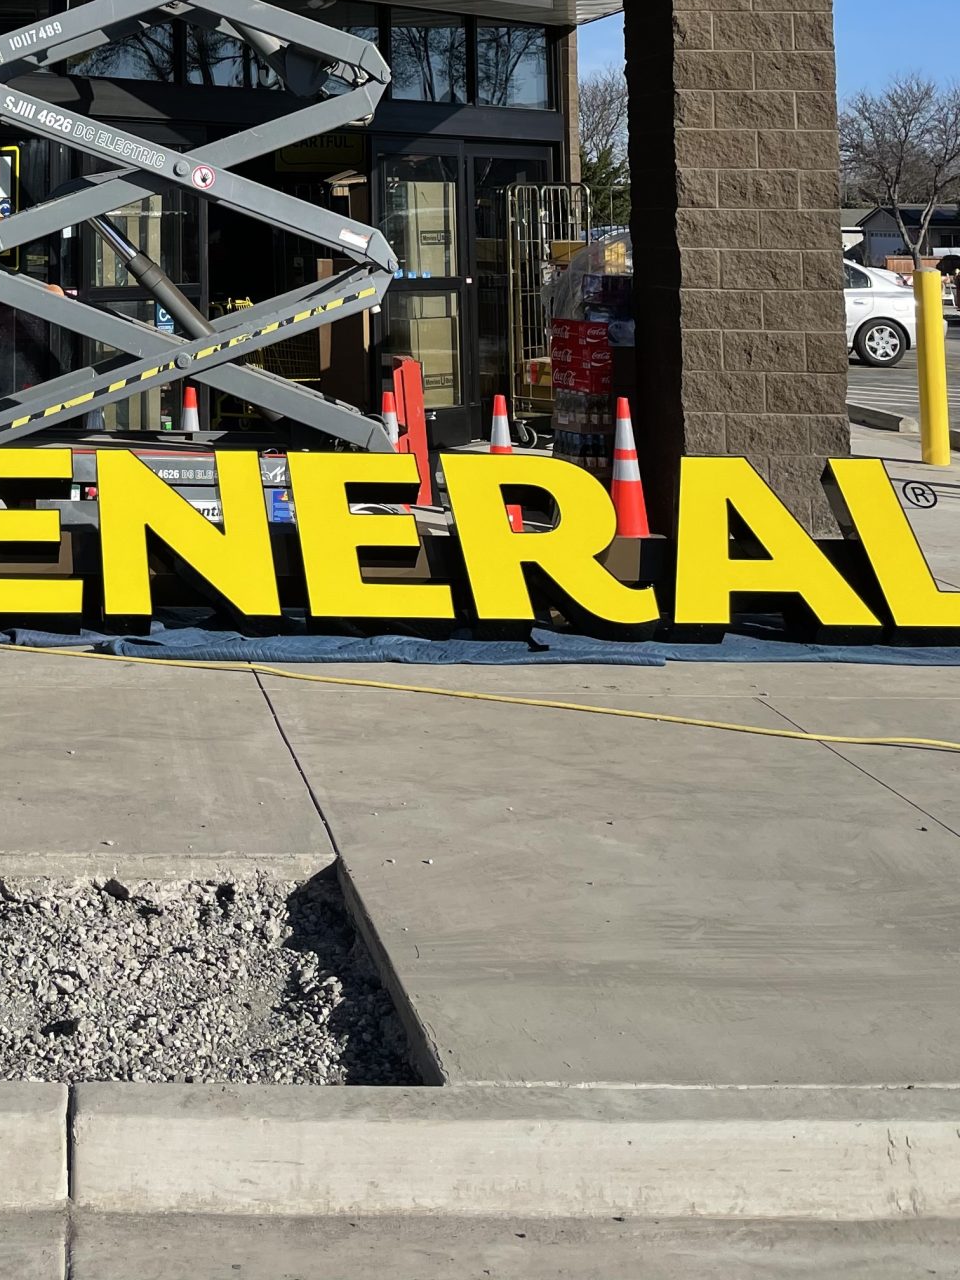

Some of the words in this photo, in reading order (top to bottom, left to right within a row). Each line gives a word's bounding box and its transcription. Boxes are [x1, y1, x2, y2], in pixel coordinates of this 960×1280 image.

[3, 95, 36, 120] SJIII
[37, 108, 73, 133] 4626
[73, 122, 95, 142] DC
[95, 131, 166, 169] ELECTRIC
